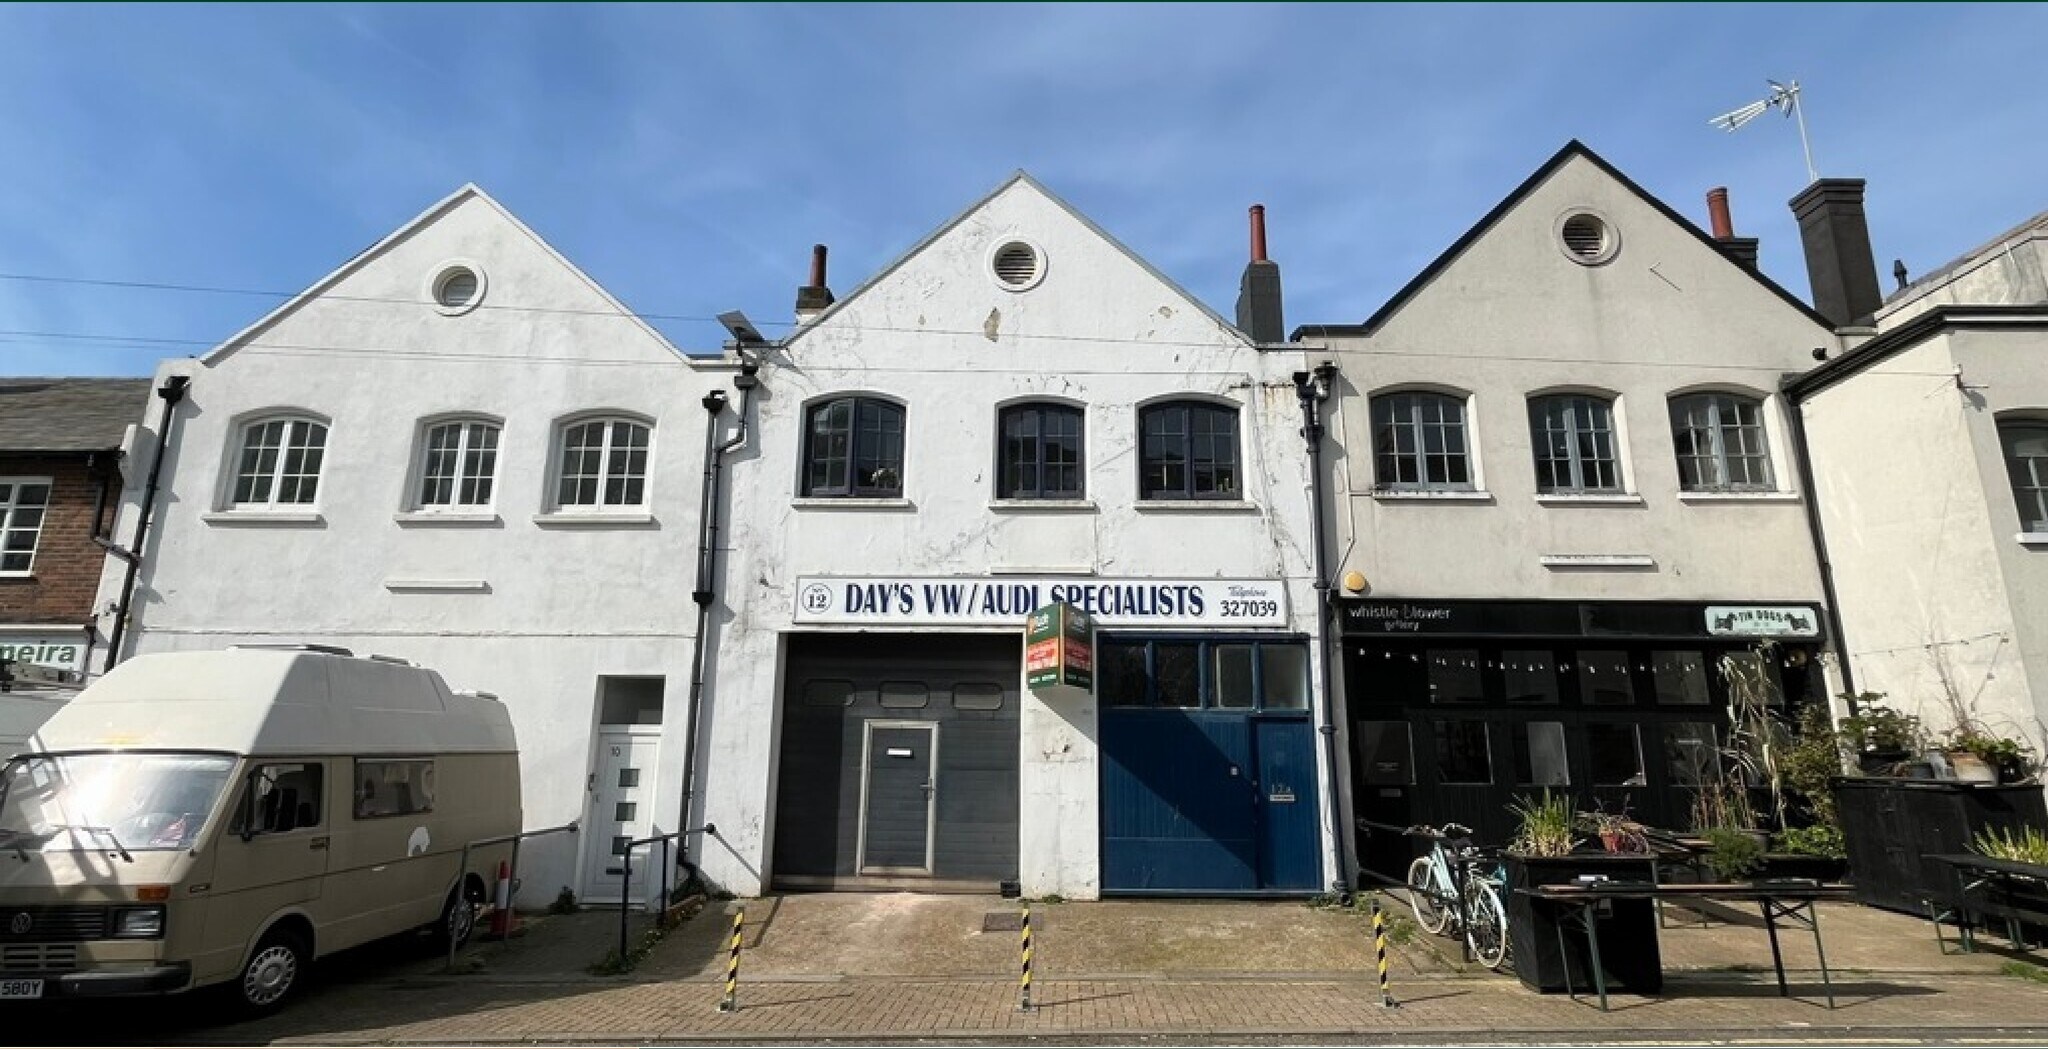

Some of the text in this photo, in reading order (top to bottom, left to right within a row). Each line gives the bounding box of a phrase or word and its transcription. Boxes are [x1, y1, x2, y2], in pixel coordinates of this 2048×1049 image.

[807, 594, 827, 608] 12
[845, 583, 914, 615] DAY'S
[1051, 584, 1204, 616] SPECIALISTS
[1220, 600, 1277, 617] 327039
[1349, 605, 1399, 618] whistle
